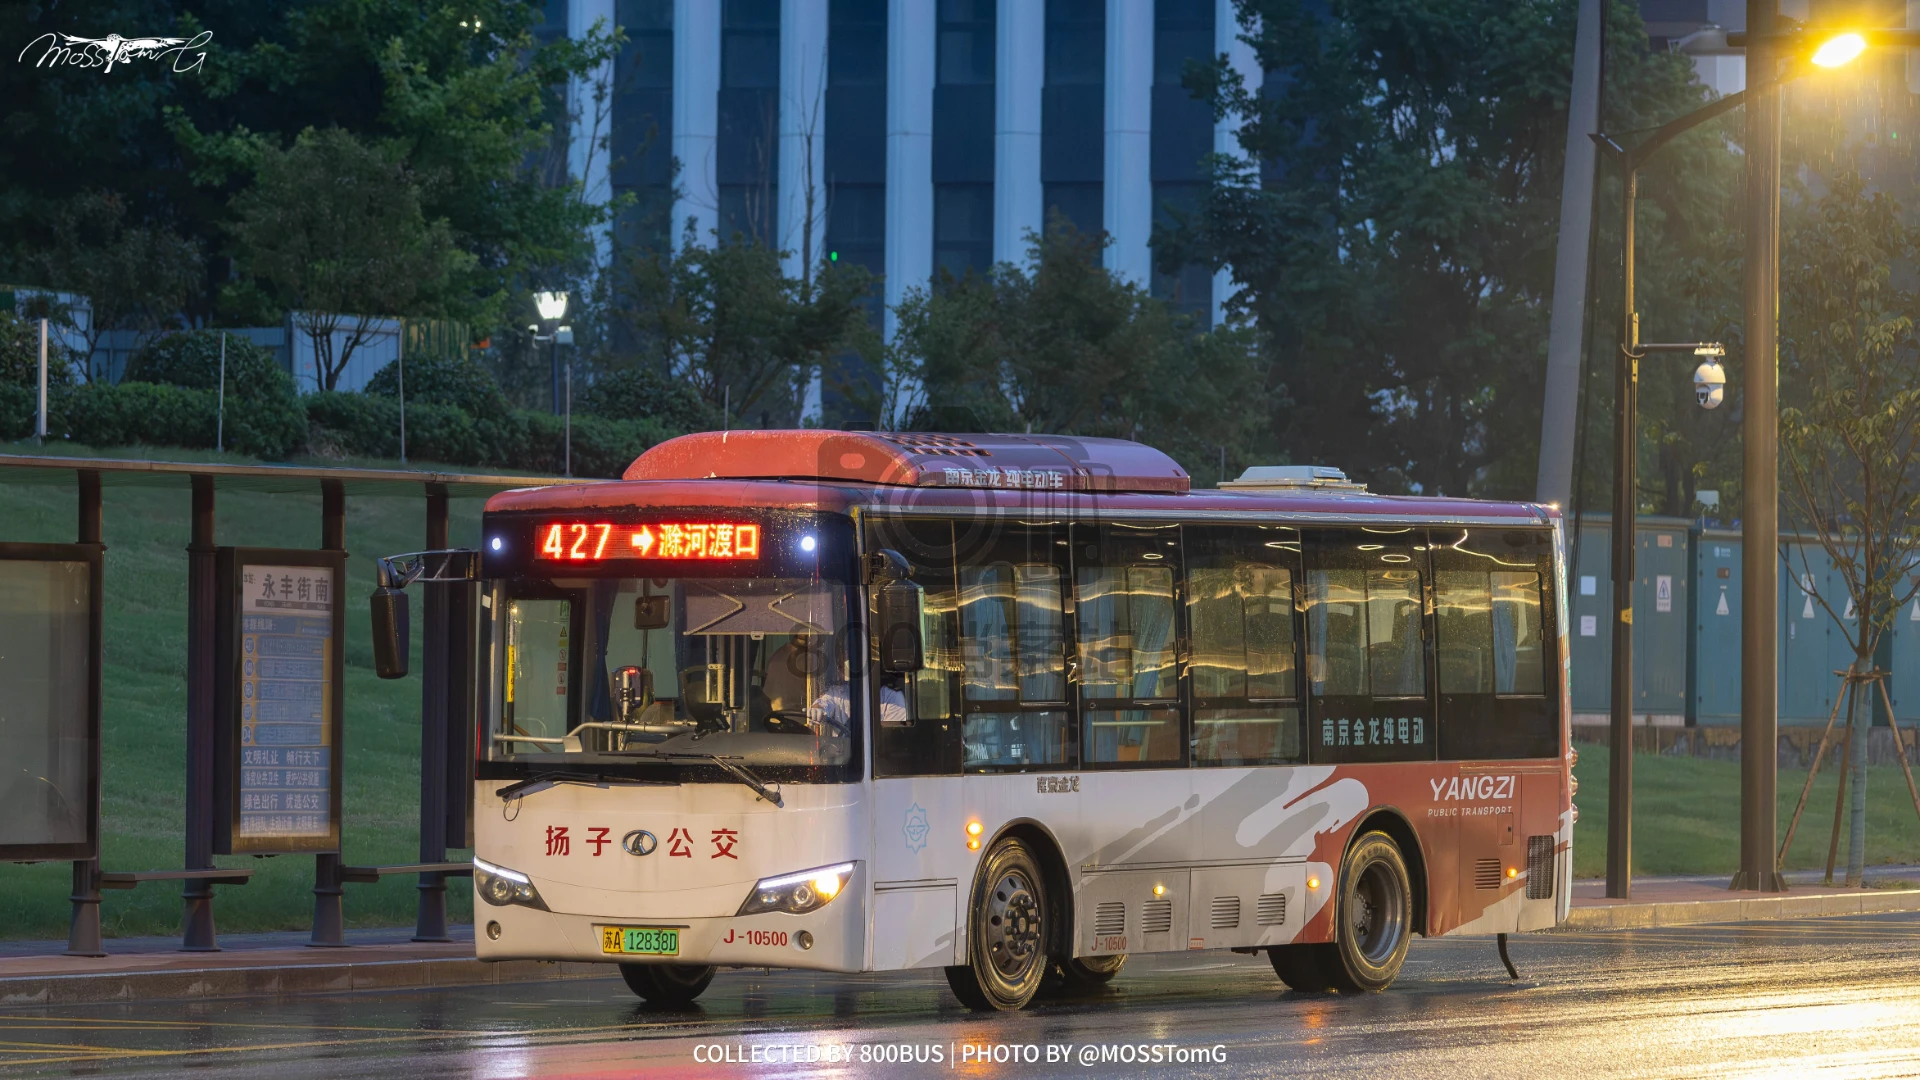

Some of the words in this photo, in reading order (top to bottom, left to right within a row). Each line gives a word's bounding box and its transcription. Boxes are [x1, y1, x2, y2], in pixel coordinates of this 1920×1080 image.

[943, 468, 1001, 487] 南京金龙
[1005, 469, 1063, 488] 纯电动车
[543, 524, 611, 559] 427
[658, 523, 756, 557] 滁河渡口
[262, 573, 328, 601] 永丰街南
[1322, 717, 1424, 746] 南京金龙纯电动
[244, 750, 279, 765] 文明礼让
[286, 750, 320, 766] 畅行天下
[1037, 775, 1080, 793] 南京金龙
[1430, 775, 1516, 801] YANGZI
[244, 794, 279, 809] 绿色出行
[1427, 807, 1458, 817] PUBLIC
[1461, 806, 1512, 816] TRANSPORT
[723, 929, 788, 947] J-10500
[1091, 936, 1127, 951] J-10500
